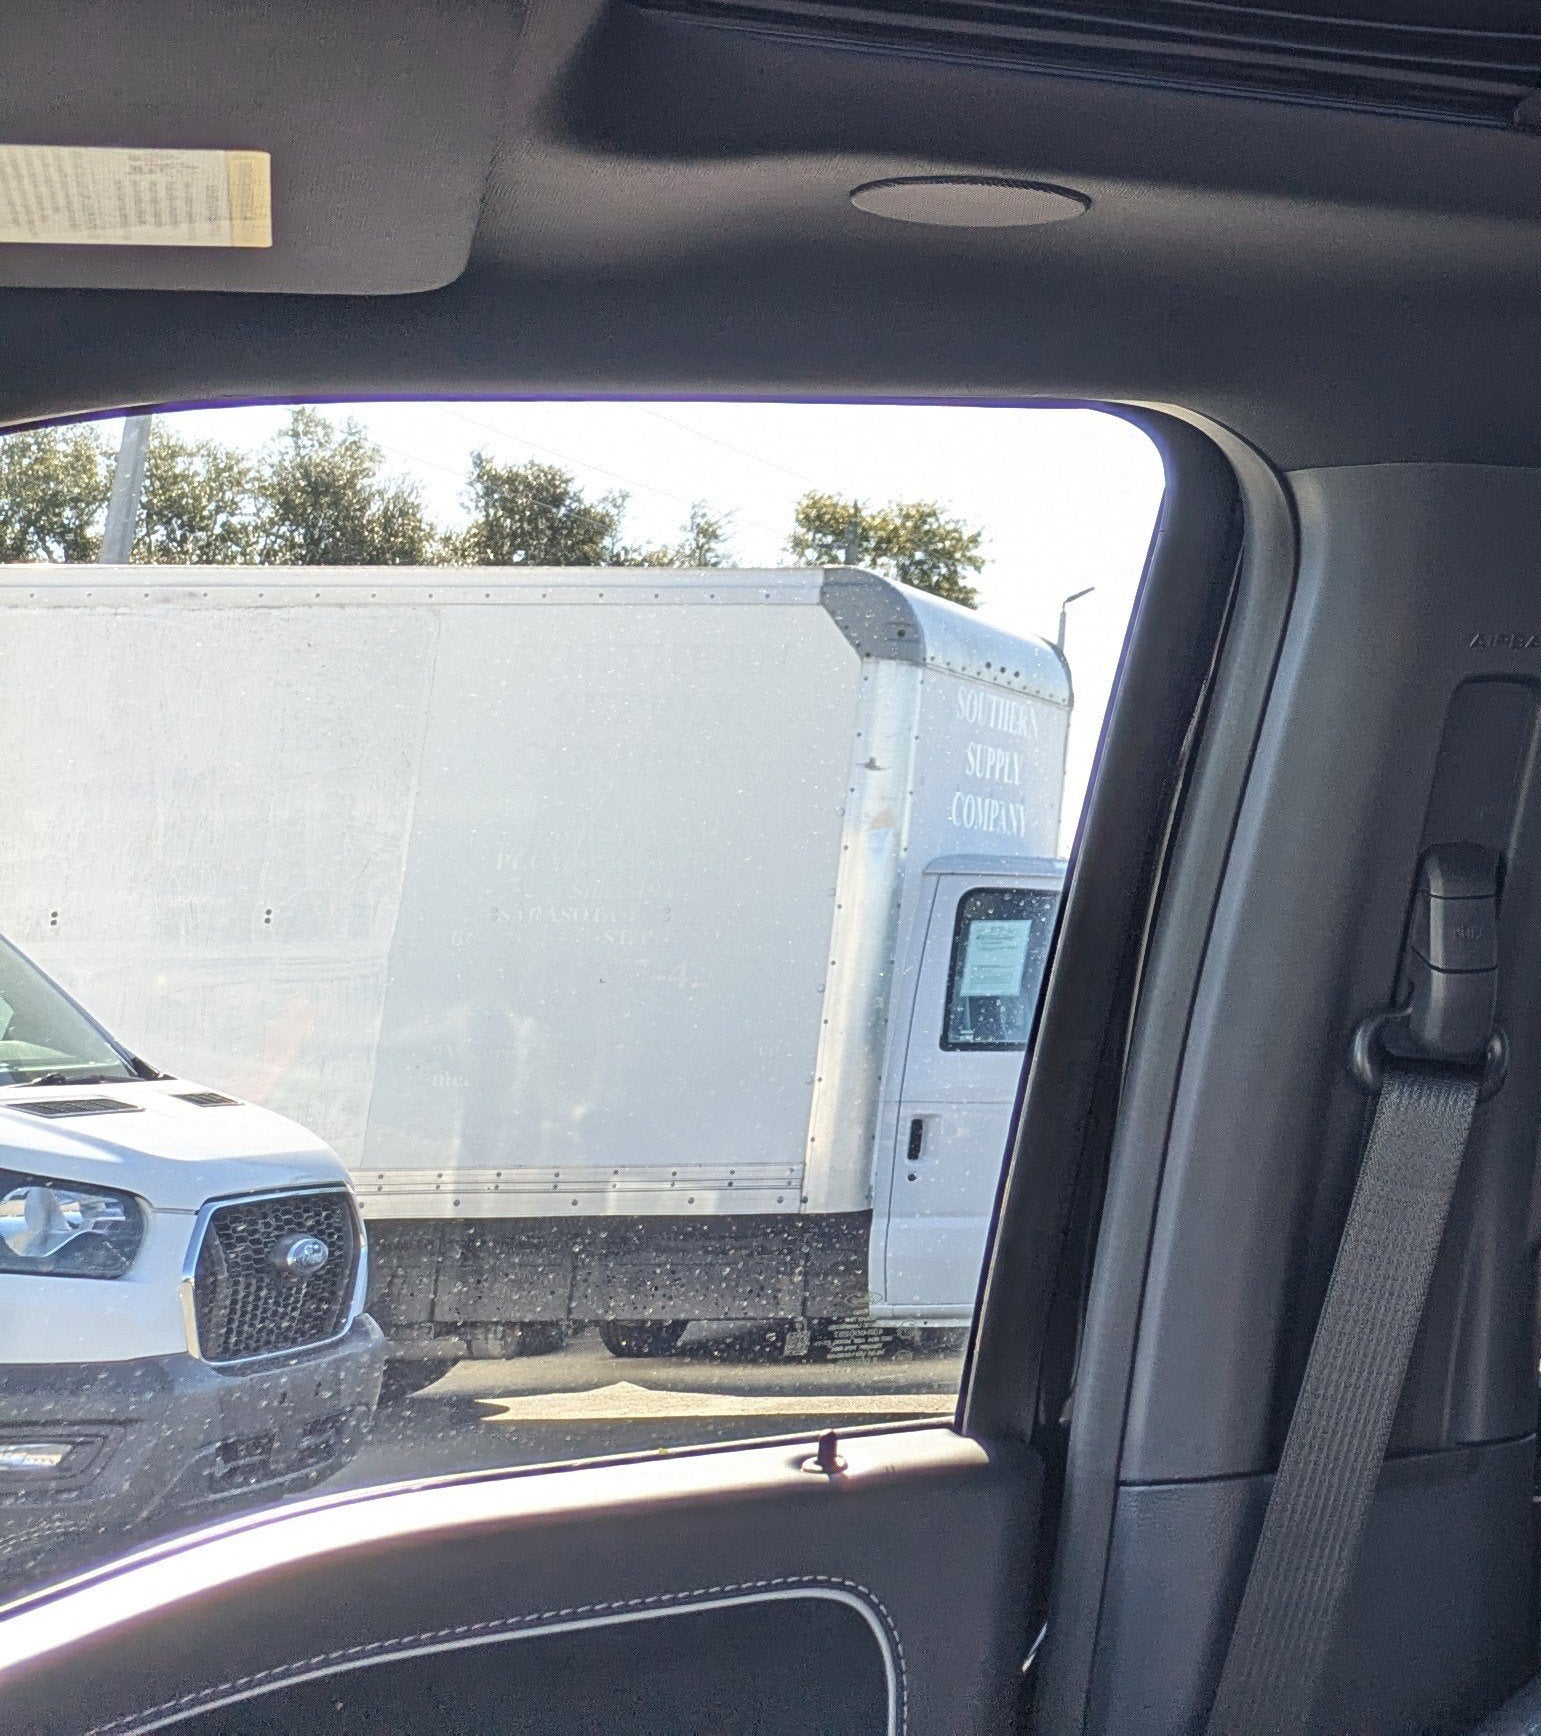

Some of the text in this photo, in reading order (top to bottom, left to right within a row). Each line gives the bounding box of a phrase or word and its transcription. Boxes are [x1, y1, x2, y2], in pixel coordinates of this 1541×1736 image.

[957, 685, 1039, 739] SOUTHERN
[965, 741, 1022, 786] SUPPLY
[951, 791, 1026, 837] COMPANY
